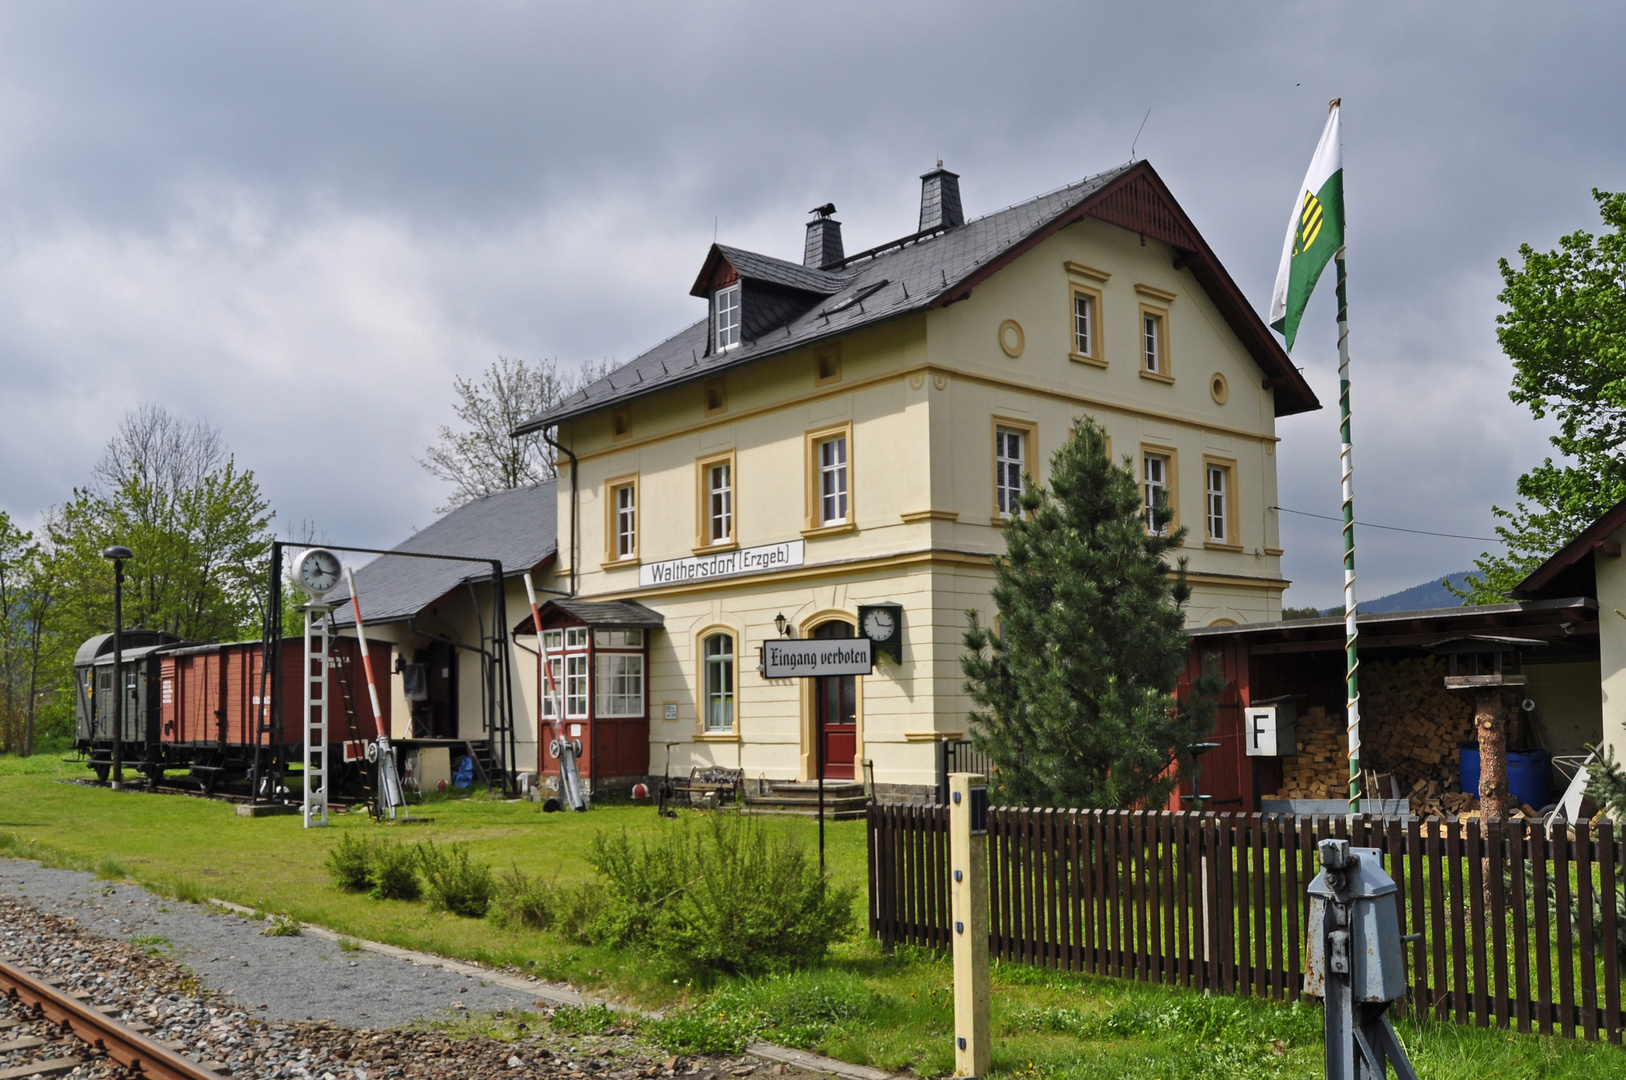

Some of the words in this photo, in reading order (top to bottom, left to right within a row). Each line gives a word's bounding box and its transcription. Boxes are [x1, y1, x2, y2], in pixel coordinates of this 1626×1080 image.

[651, 552, 736, 583] Walthersdorf
[739, 544, 789, 570] (Erzgeb.)
[770, 648, 817, 670] Eingang
[821, 646, 867, 665] verboten
[1253, 715, 1269, 749] F
